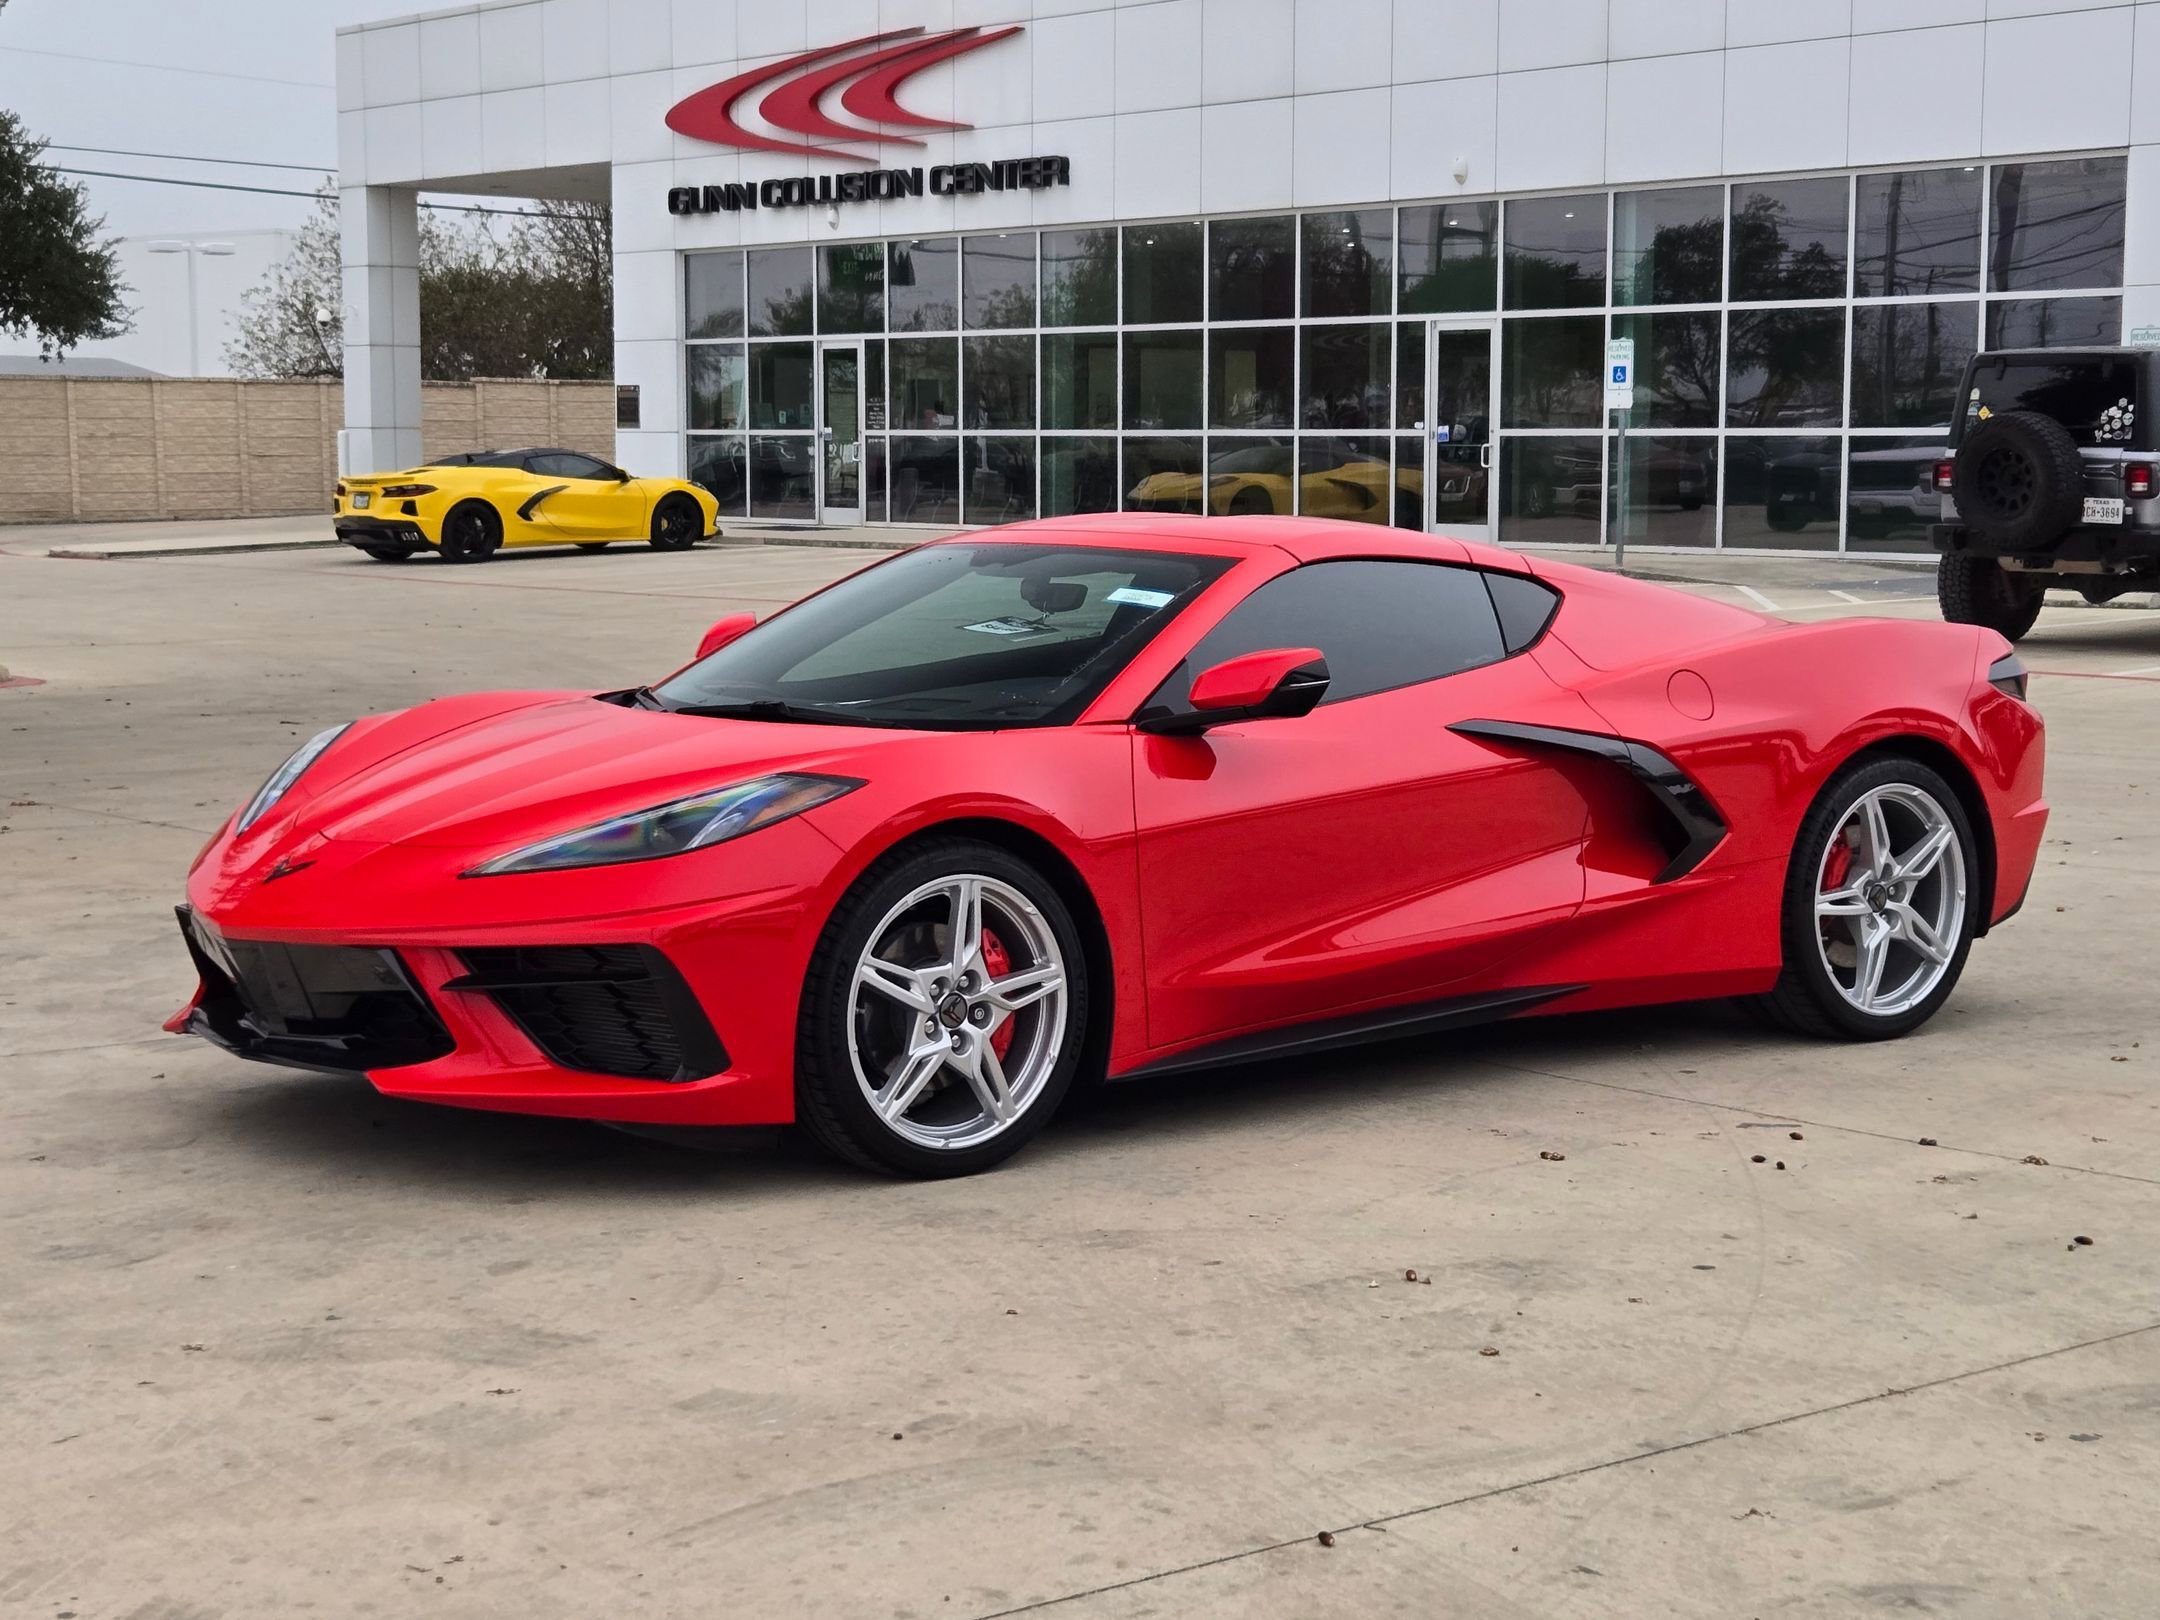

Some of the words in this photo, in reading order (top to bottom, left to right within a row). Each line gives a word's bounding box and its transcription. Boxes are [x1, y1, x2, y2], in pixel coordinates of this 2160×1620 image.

[668, 181, 758, 215] GUNN
[760, 167, 924, 208] COLLISION
[930, 155, 1070, 195] CENTER
